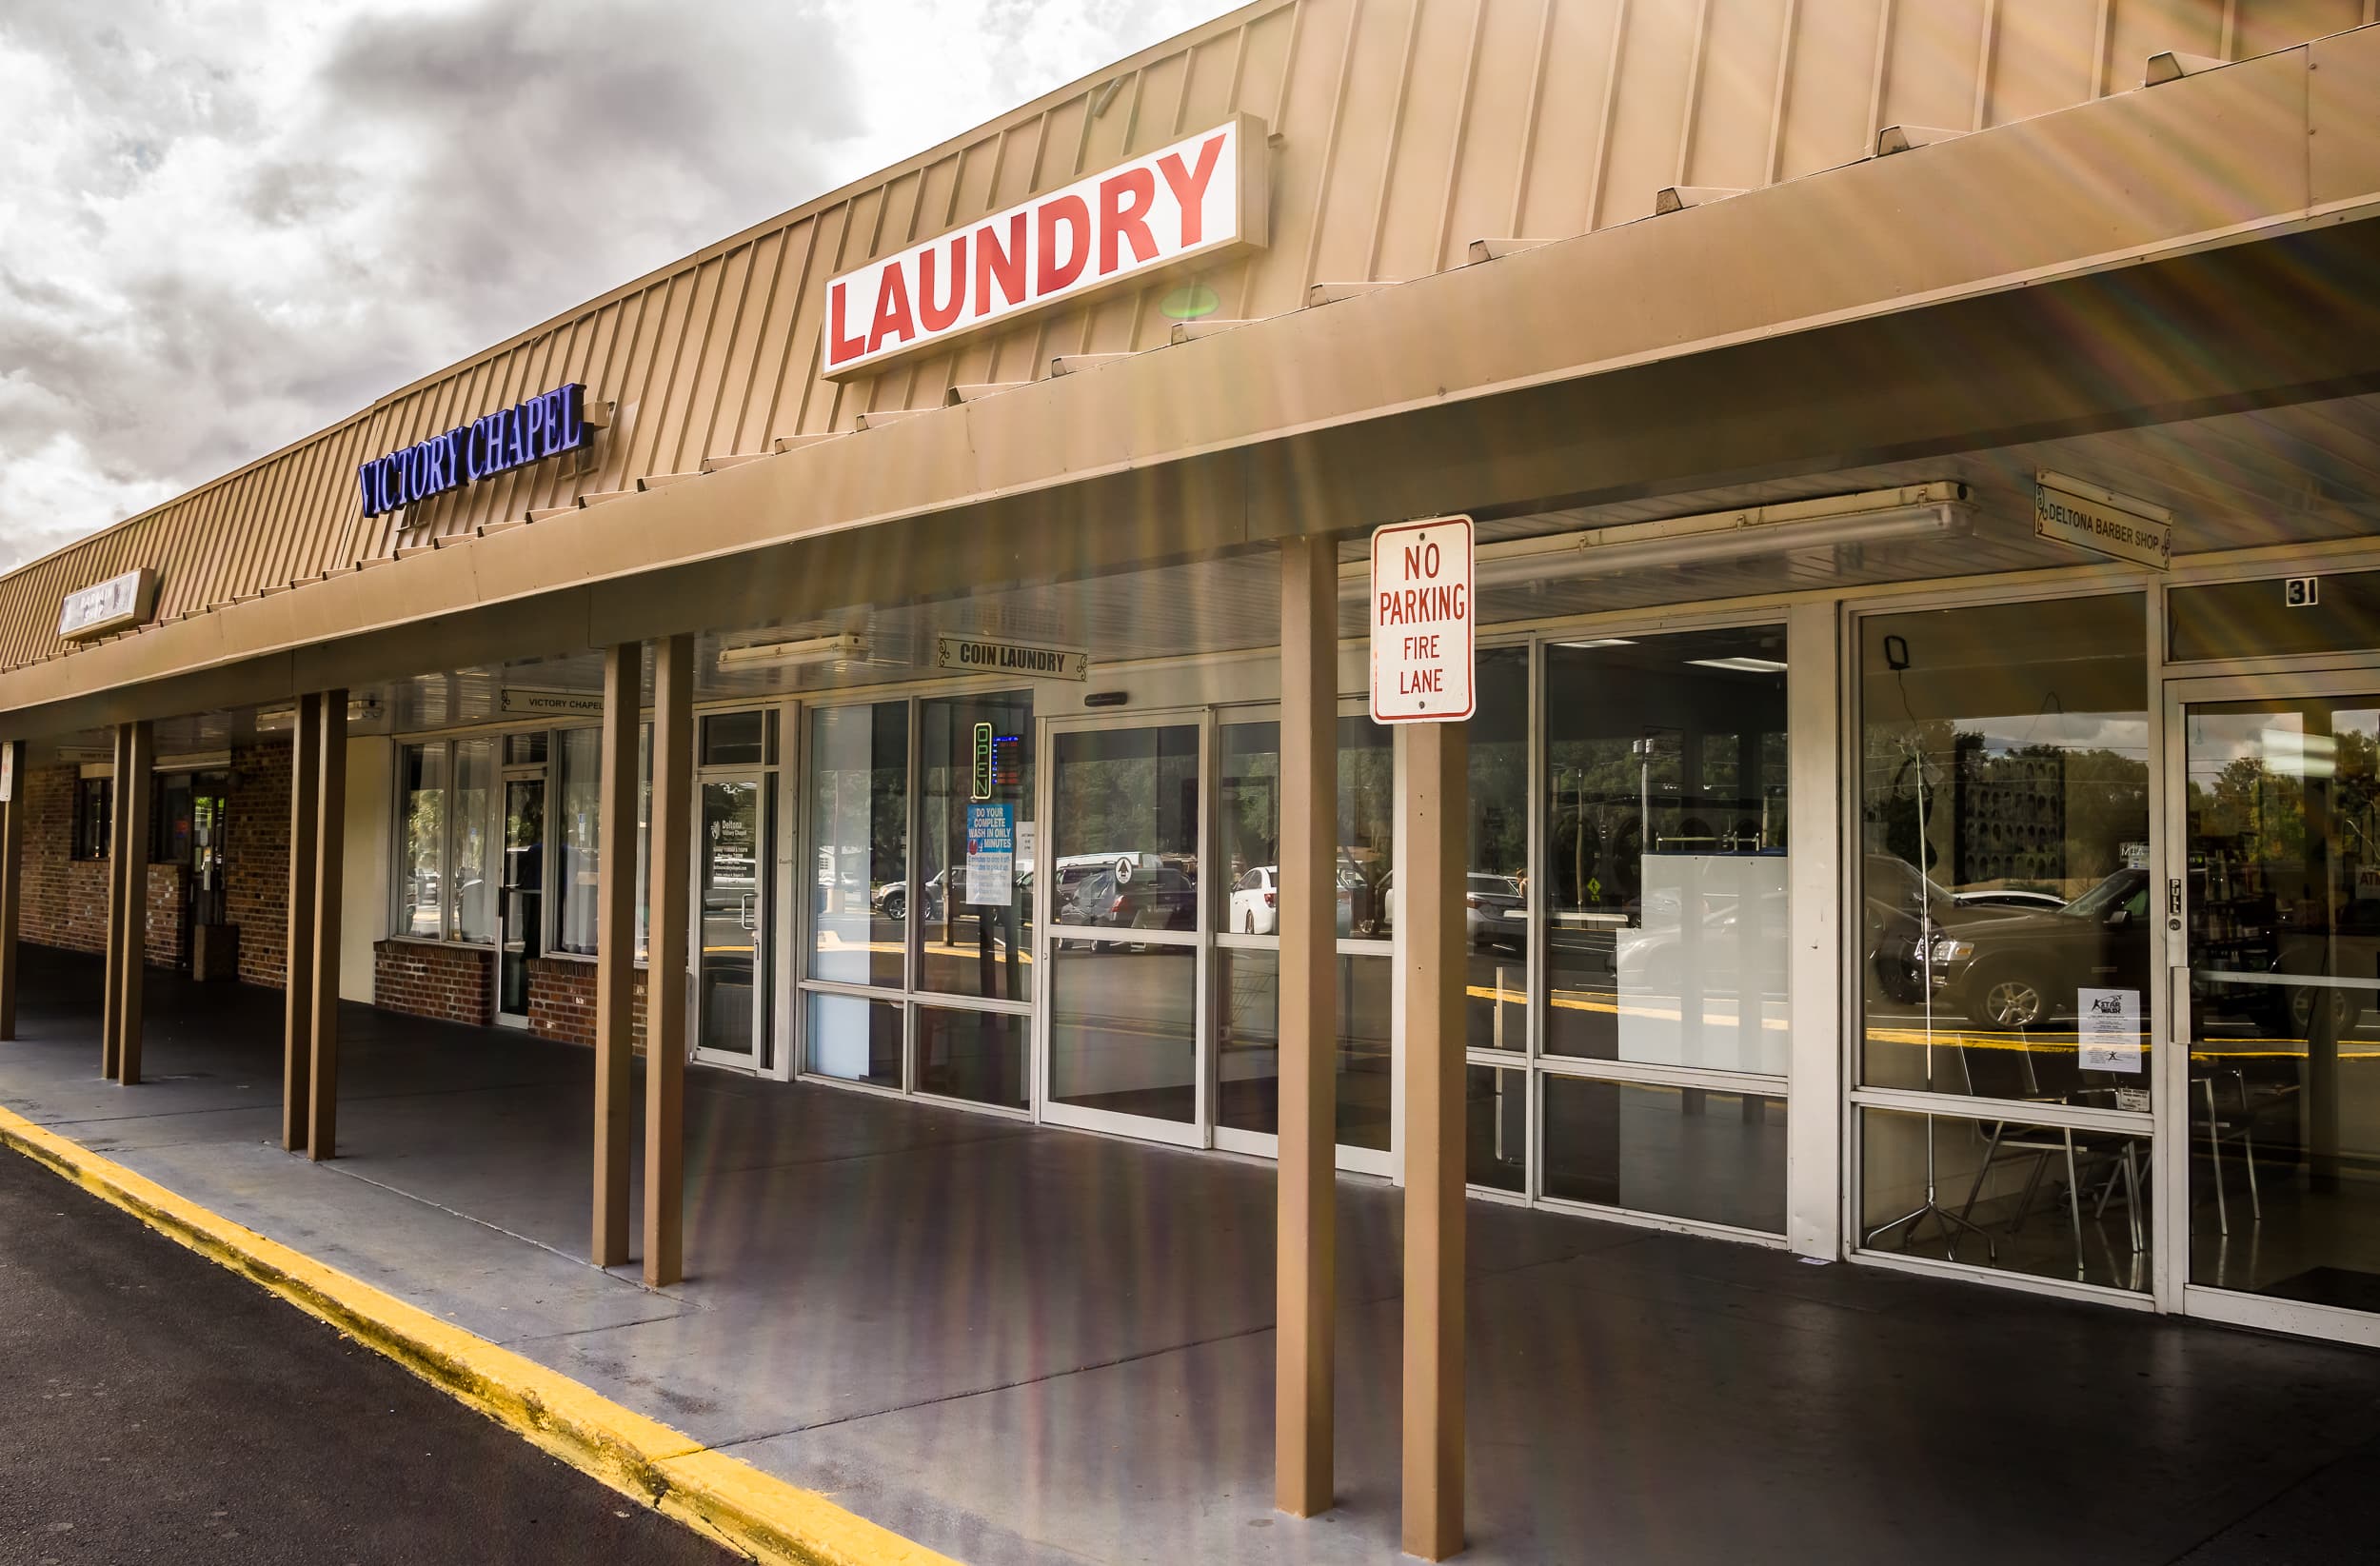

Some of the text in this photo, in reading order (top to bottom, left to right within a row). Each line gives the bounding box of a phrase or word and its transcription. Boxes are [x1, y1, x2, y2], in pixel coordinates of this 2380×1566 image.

[830, 133, 1226, 366] LAUNDRY
[359, 385, 582, 517] VICTORY CHAPEL
[2049, 504, 2159, 551] DELTONA BARBER SHOP
[1404, 543, 1440, 581] NO
[1380, 584, 1465, 626] PARKING
[2289, 579, 2316, 605] 31
[960, 643, 1066, 673] COIN LAUNDRY
[1404, 635, 1440, 661] FIRE
[1399, 668, 1443, 695] LANE
[528, 698, 604, 710] VICTORY CHAPEL
[977, 728, 988, 795] OPEN
[722, 820, 743, 829] Deltona
[973, 818, 1006, 827] COMPLETE
[976, 807, 1003, 818] DO YOUR
[968, 828, 1011, 838] WASH IN ONLY
[984, 839, 1011, 848] MINUTES
